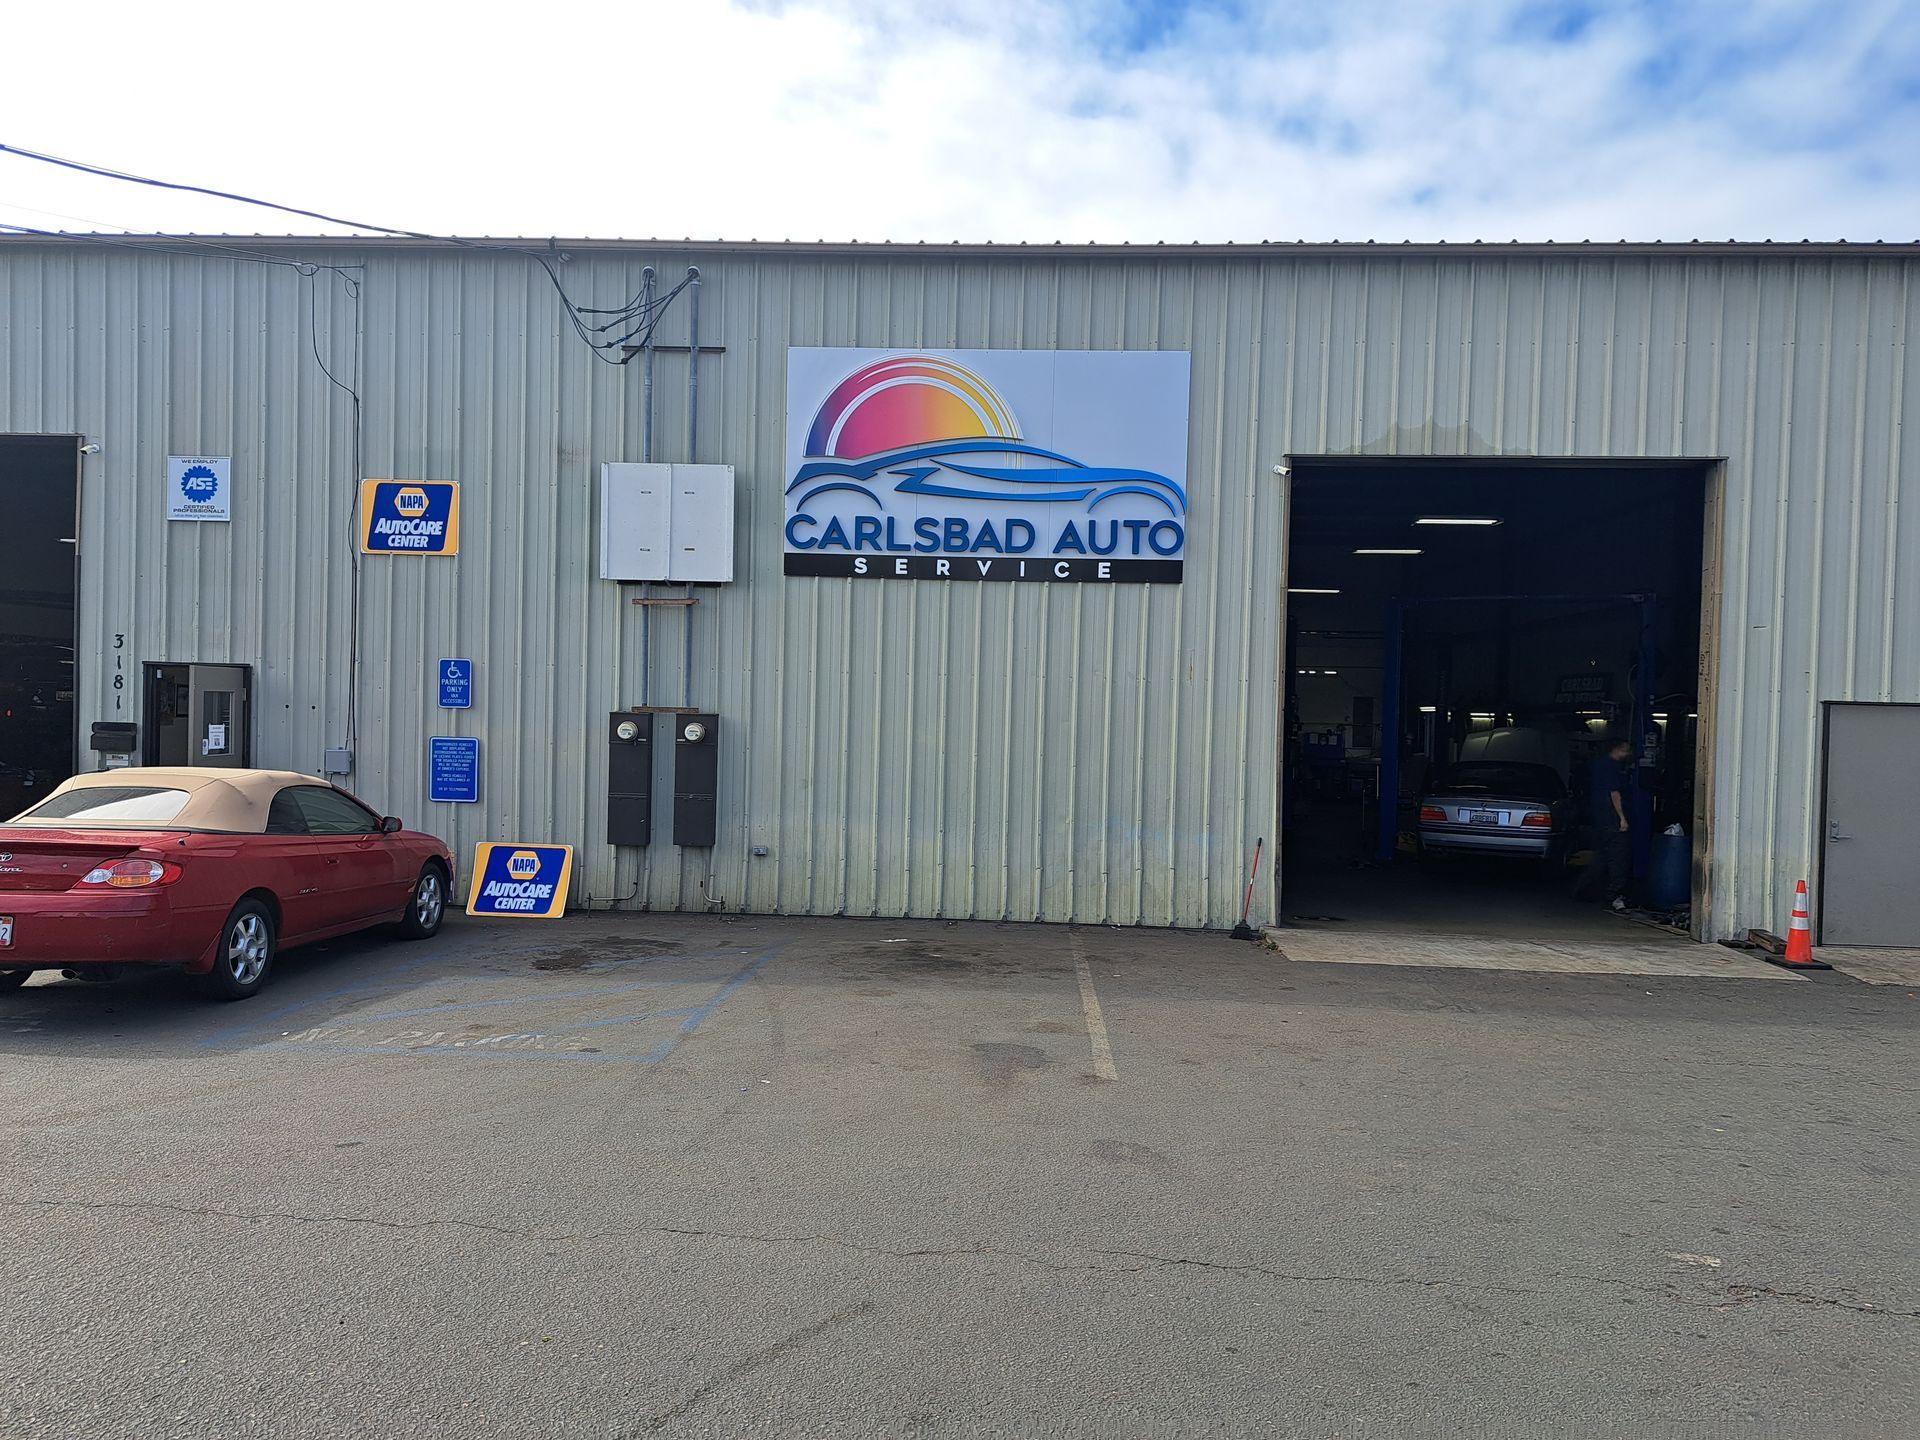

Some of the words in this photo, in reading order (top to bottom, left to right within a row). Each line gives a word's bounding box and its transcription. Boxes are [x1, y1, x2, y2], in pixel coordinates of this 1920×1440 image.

[185, 477, 213, 490] ASE
[400, 495, 424, 509] NAPA
[388, 535, 429, 547] CENTER
[785, 514, 1036, 554] CARLSBAD
[1052, 519, 1184, 555] AUTO
[854, 557, 1112, 579] SERVICE
[512, 858, 536, 872] NAPA
[495, 898, 536, 910] CENTER
